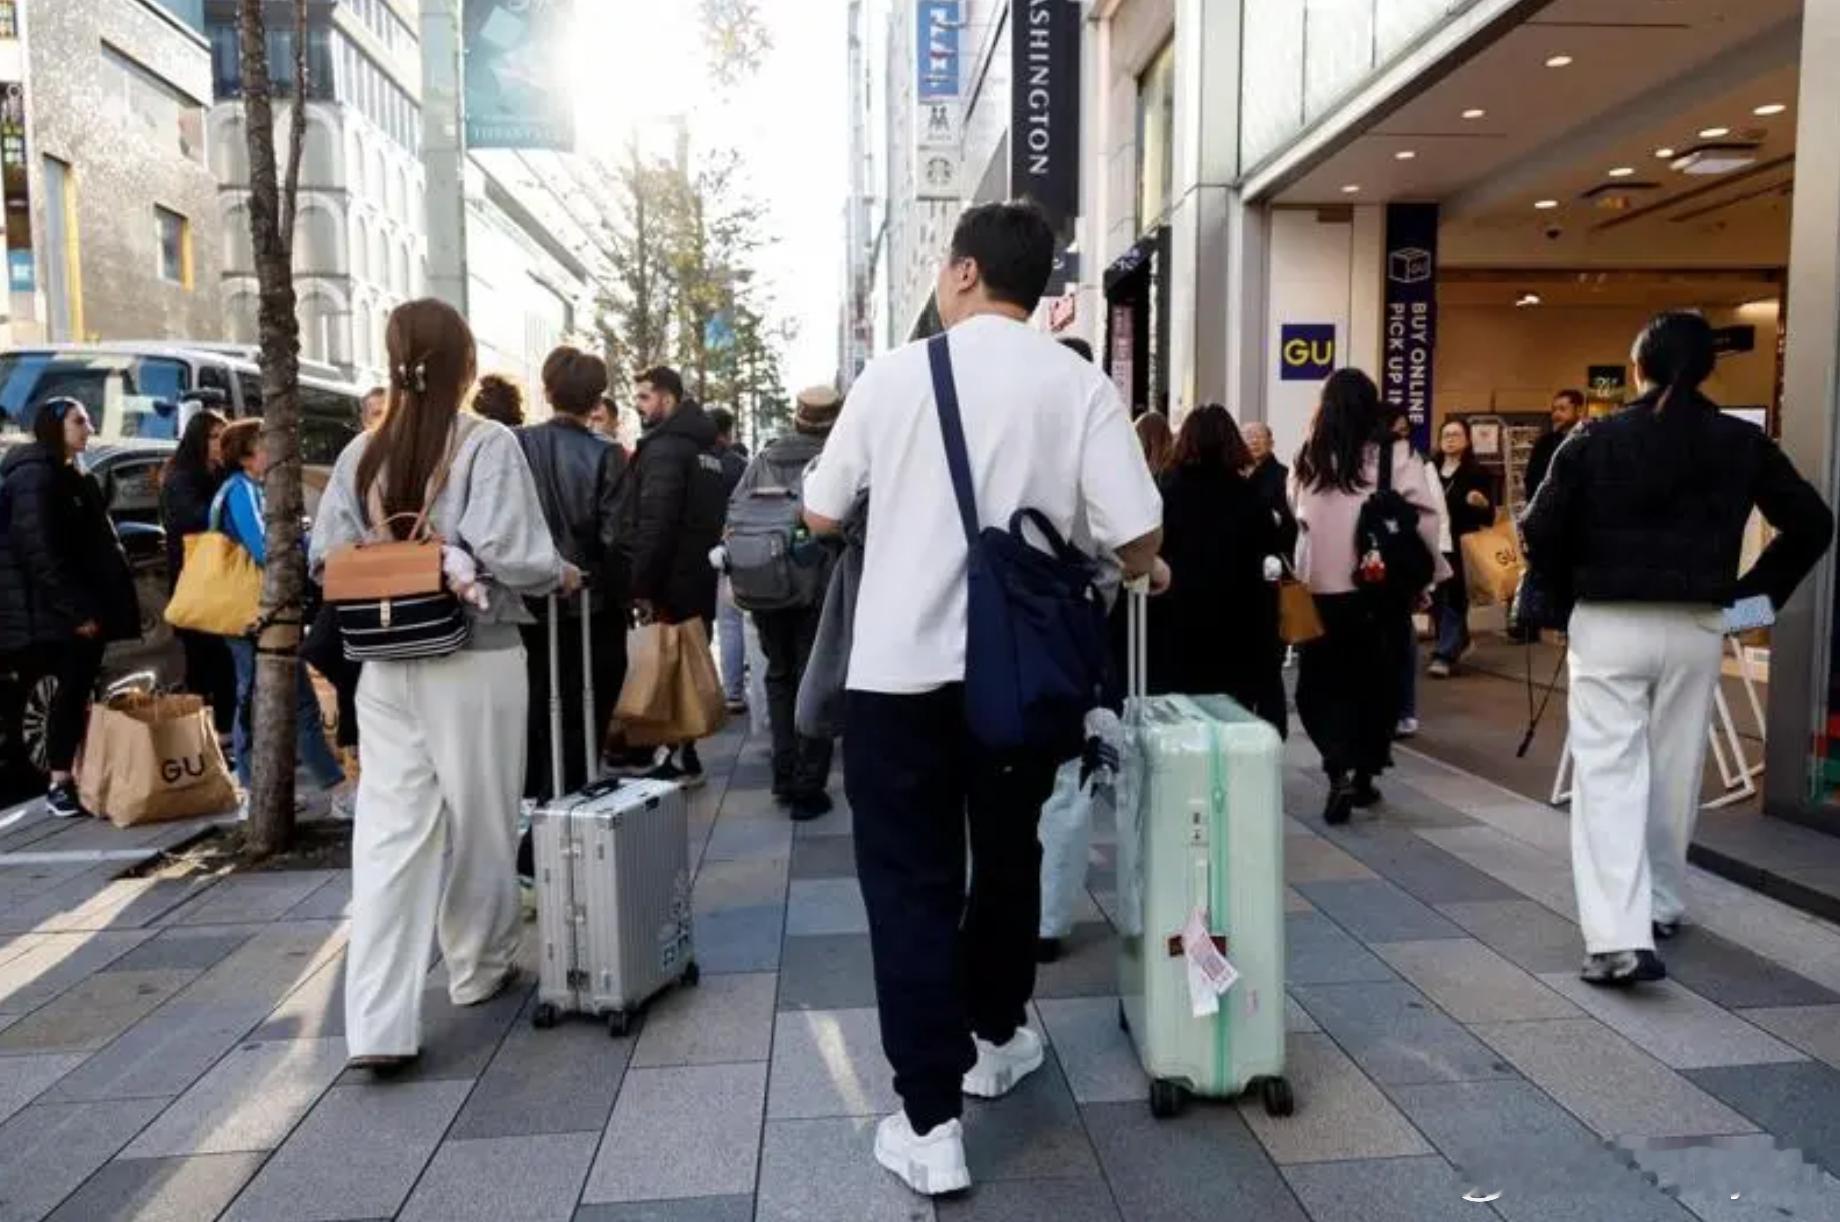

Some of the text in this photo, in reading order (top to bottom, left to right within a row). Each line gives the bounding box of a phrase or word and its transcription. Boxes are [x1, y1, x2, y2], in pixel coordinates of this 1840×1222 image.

[1388, 303, 1405, 350] PICK
[1284, 338, 1333, 367] GU
[1408, 302, 1427, 424] BUY ONLINE
[1388, 356, 1404, 384] UP
[161, 754, 206, 784] GU
